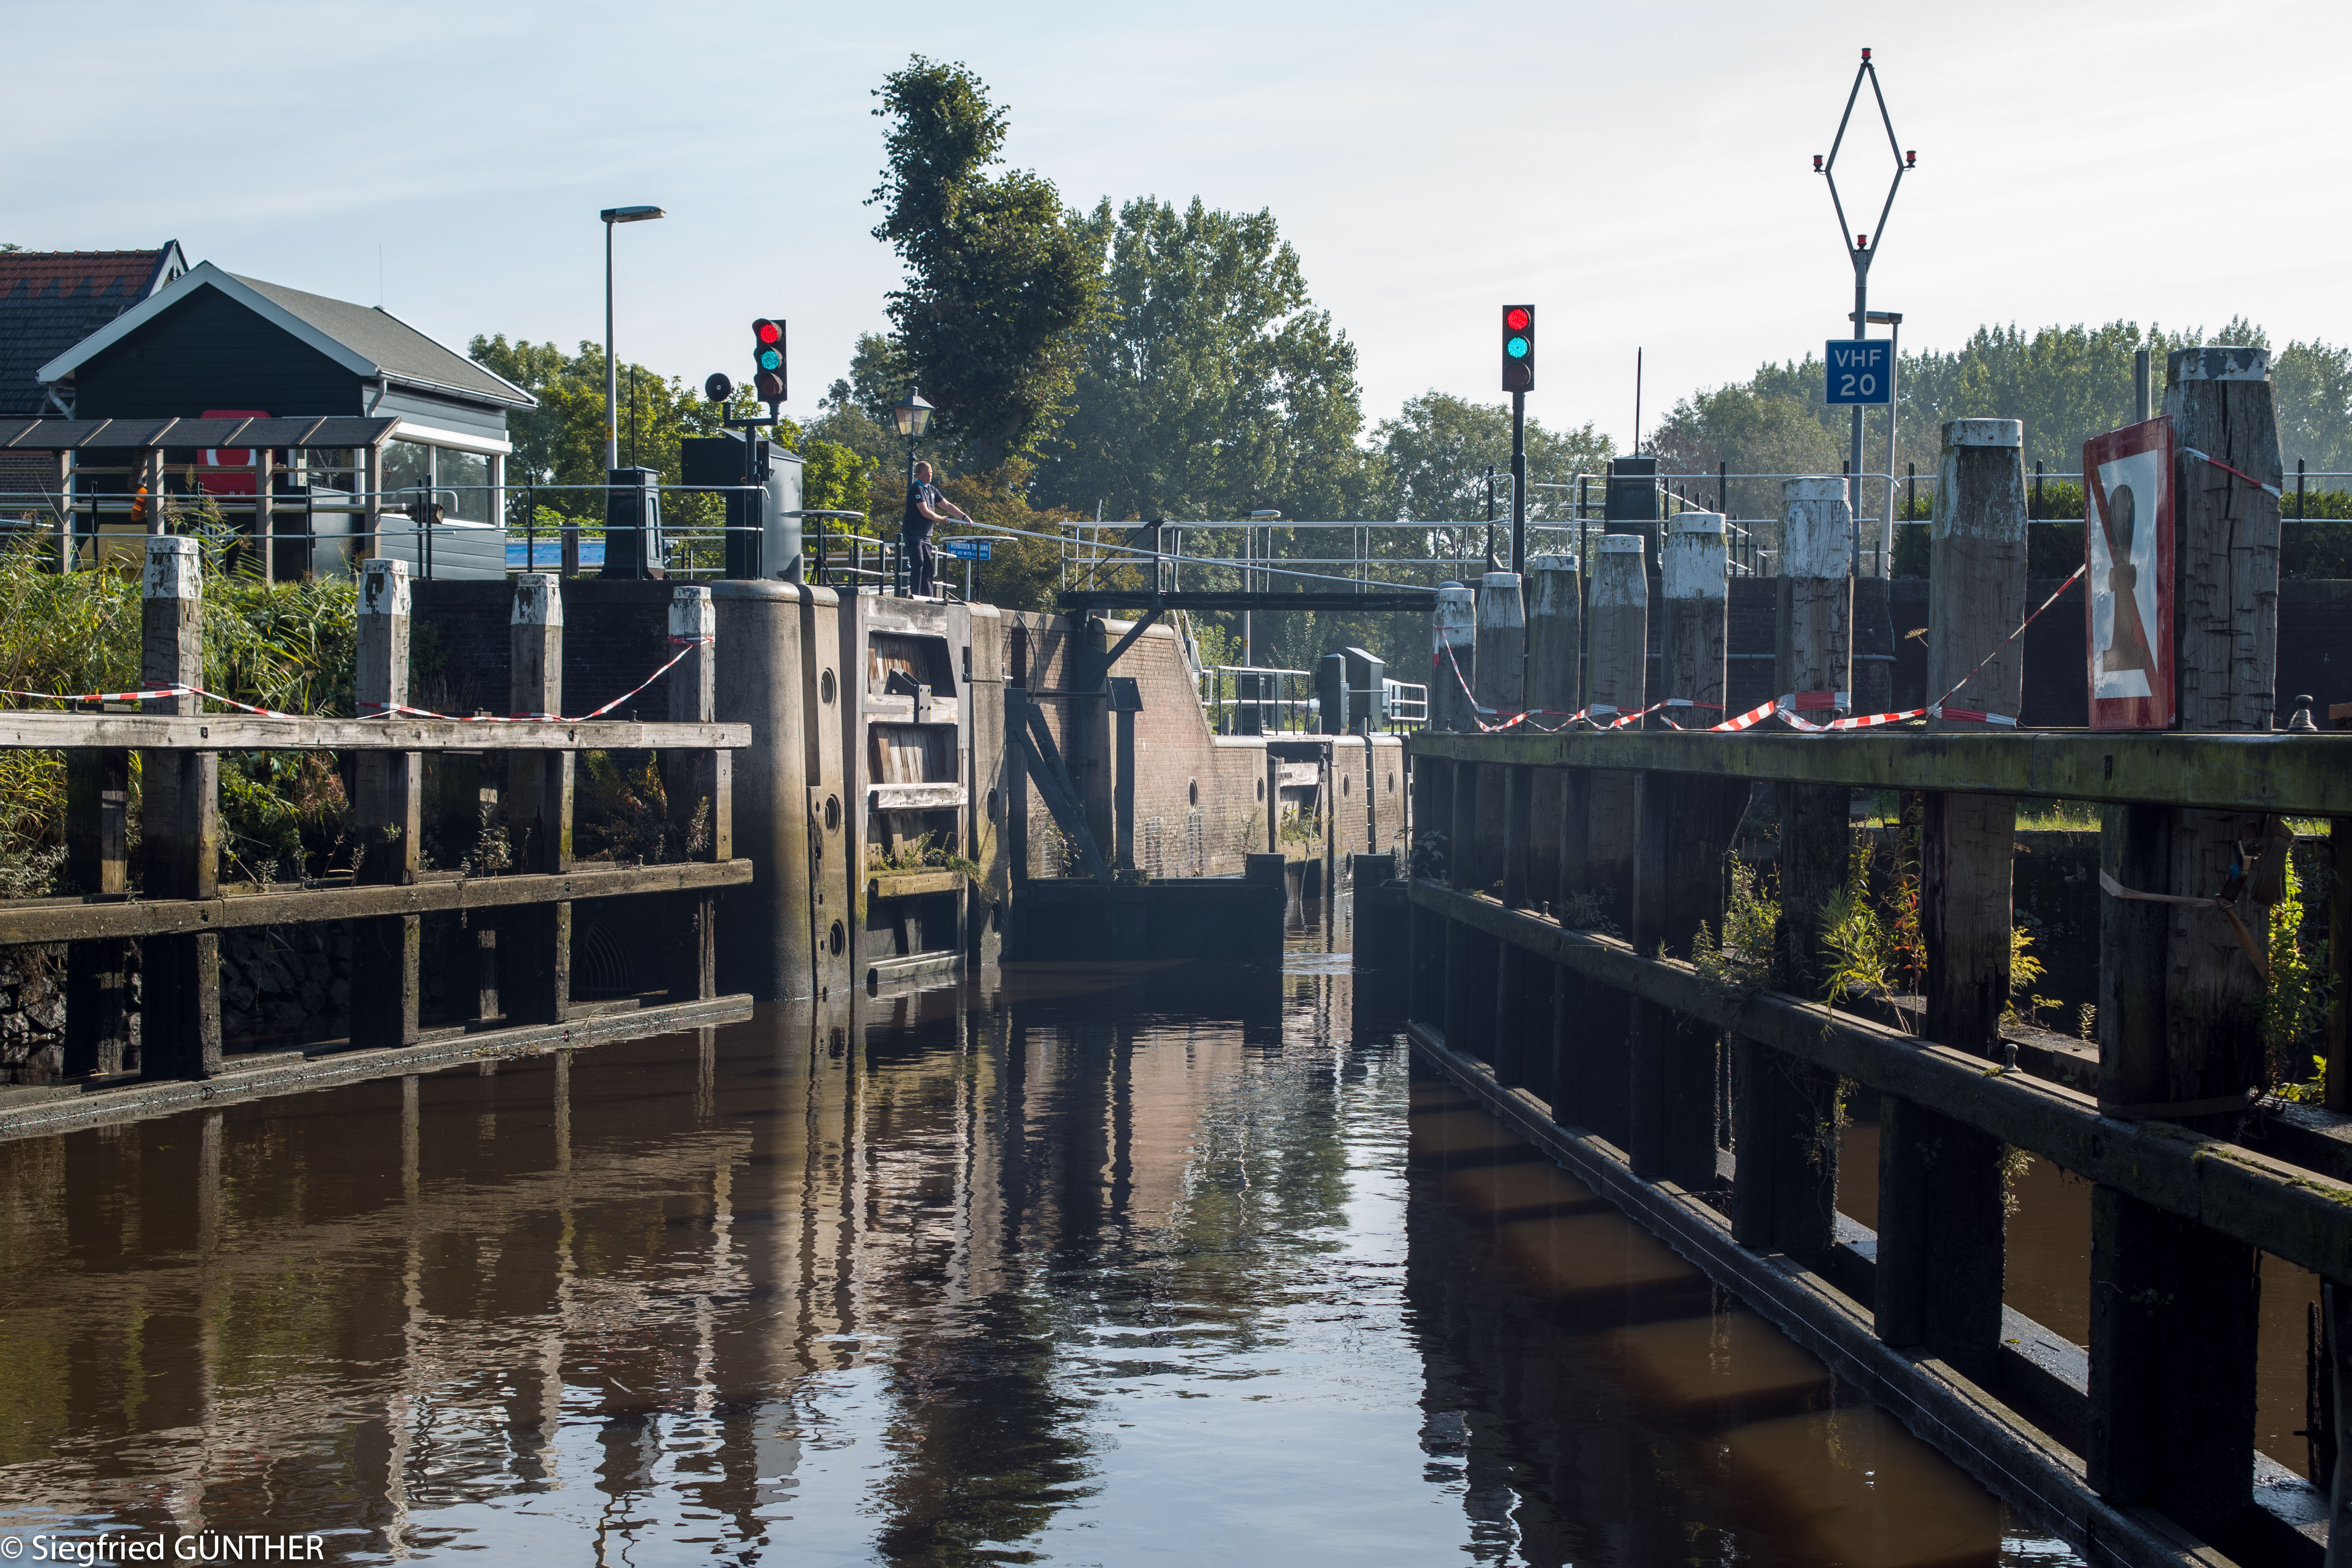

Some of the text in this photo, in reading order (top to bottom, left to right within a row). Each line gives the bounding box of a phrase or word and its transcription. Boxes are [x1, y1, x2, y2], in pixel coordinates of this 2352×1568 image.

[1835, 349, 1882, 367] VHF
[1840, 373, 1876, 396] 20
[922, 613, 933, 626] 2005
